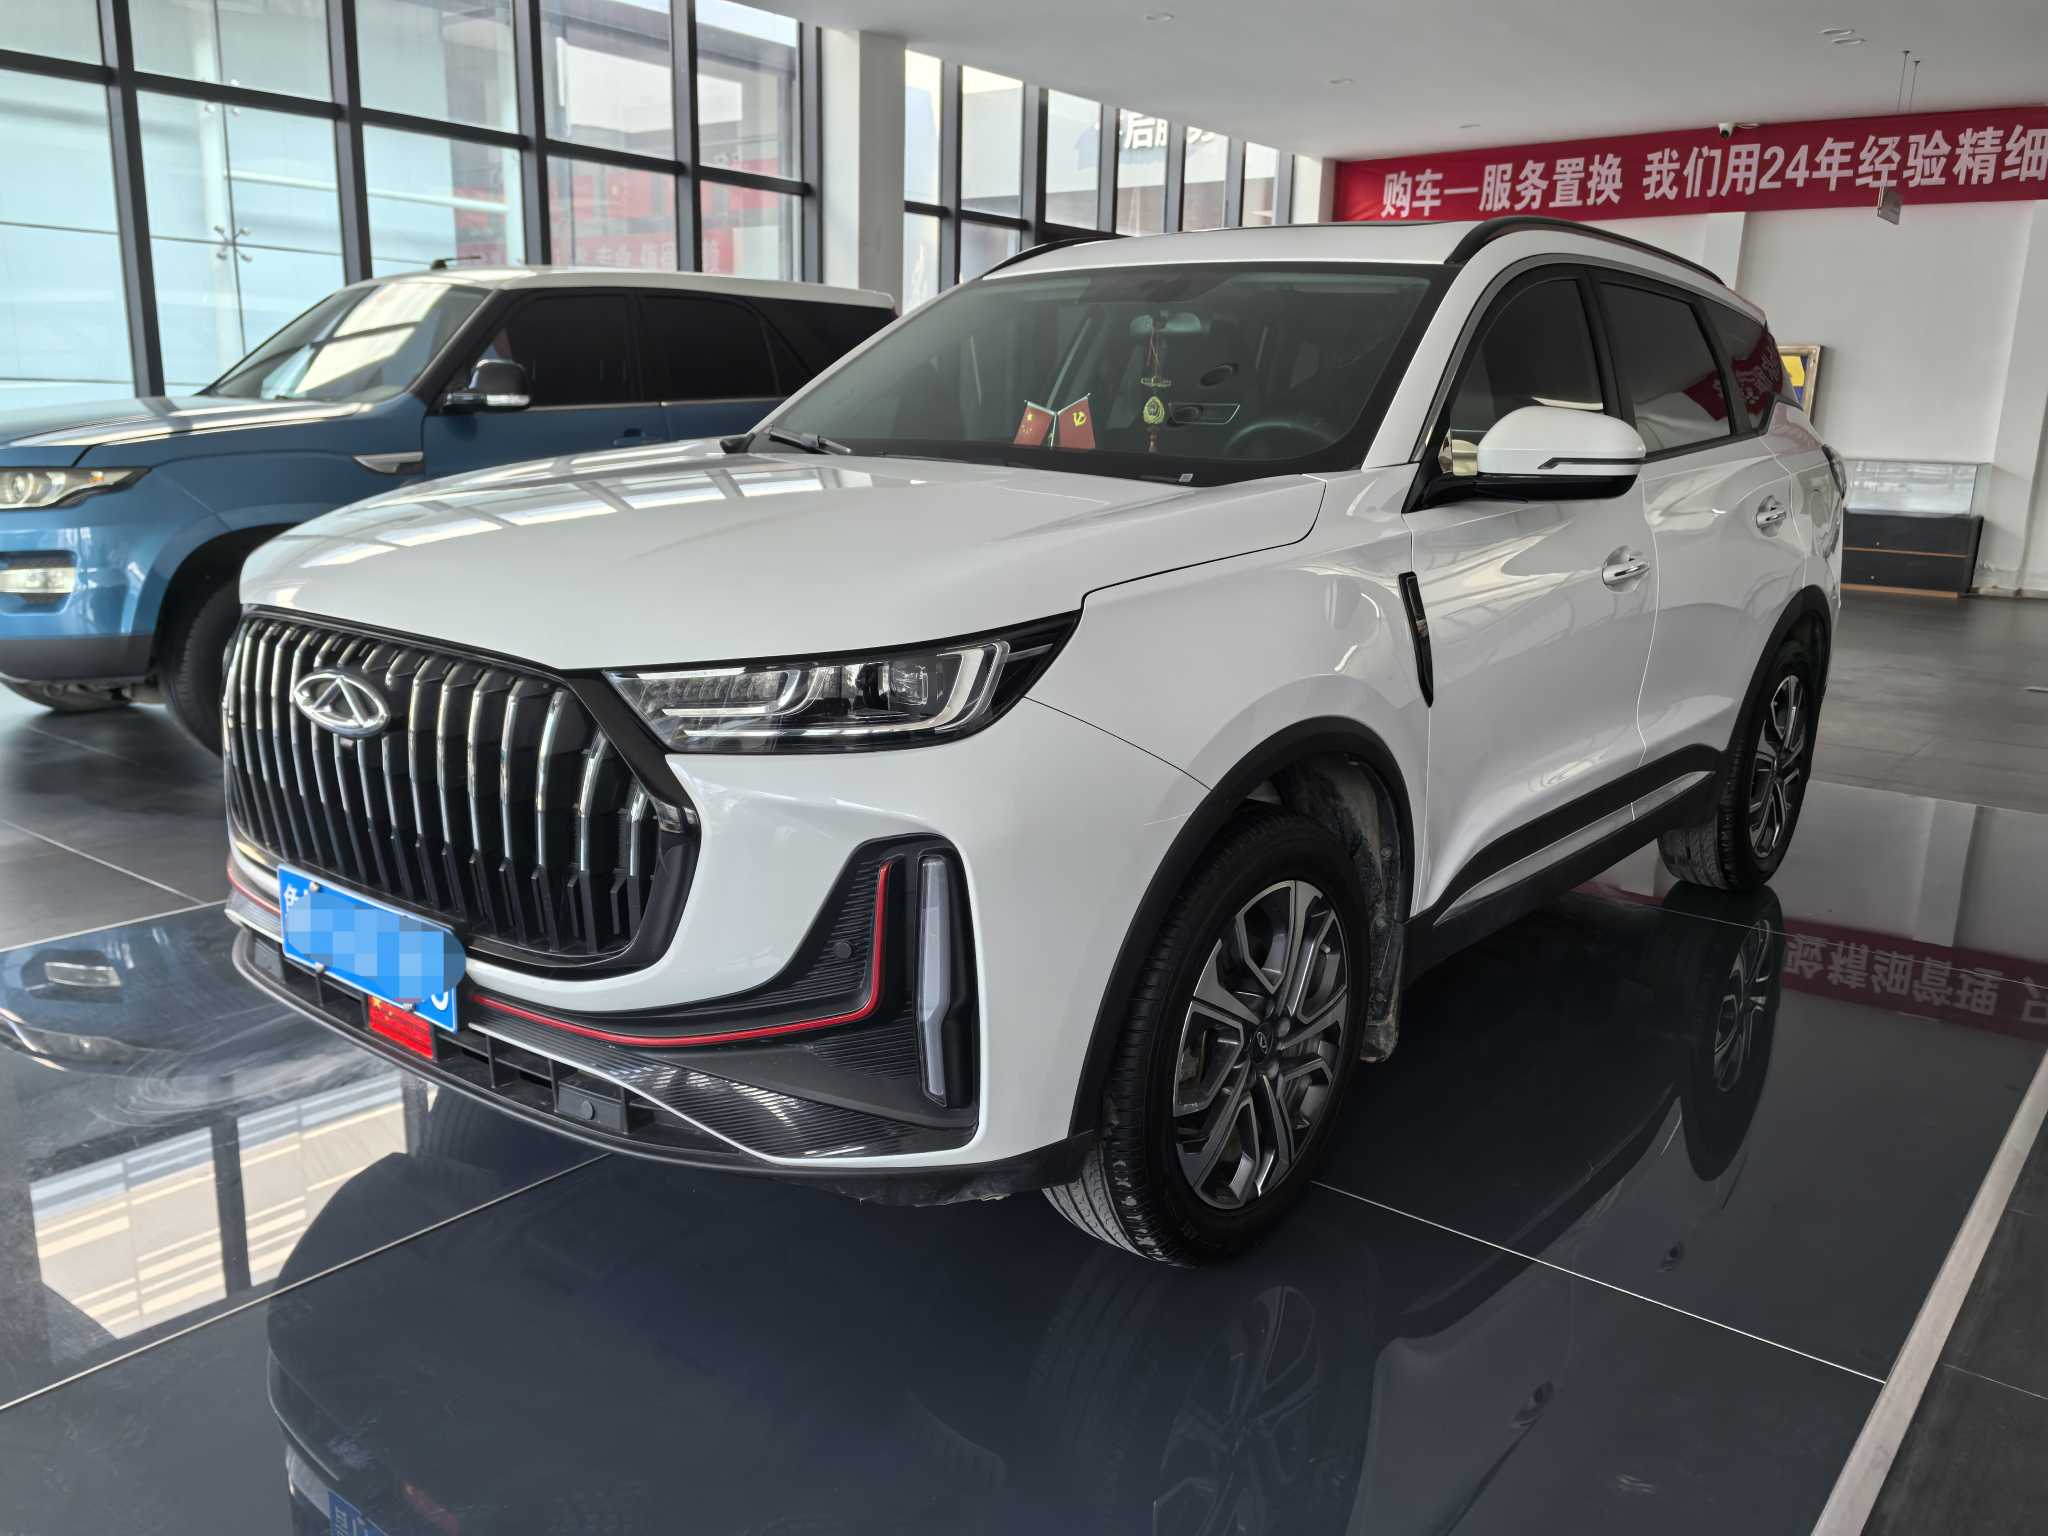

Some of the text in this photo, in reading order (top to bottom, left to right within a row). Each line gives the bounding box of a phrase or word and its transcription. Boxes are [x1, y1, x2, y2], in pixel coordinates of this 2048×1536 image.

[1642, 124, 2048, 200] 我们用24年经验精细
